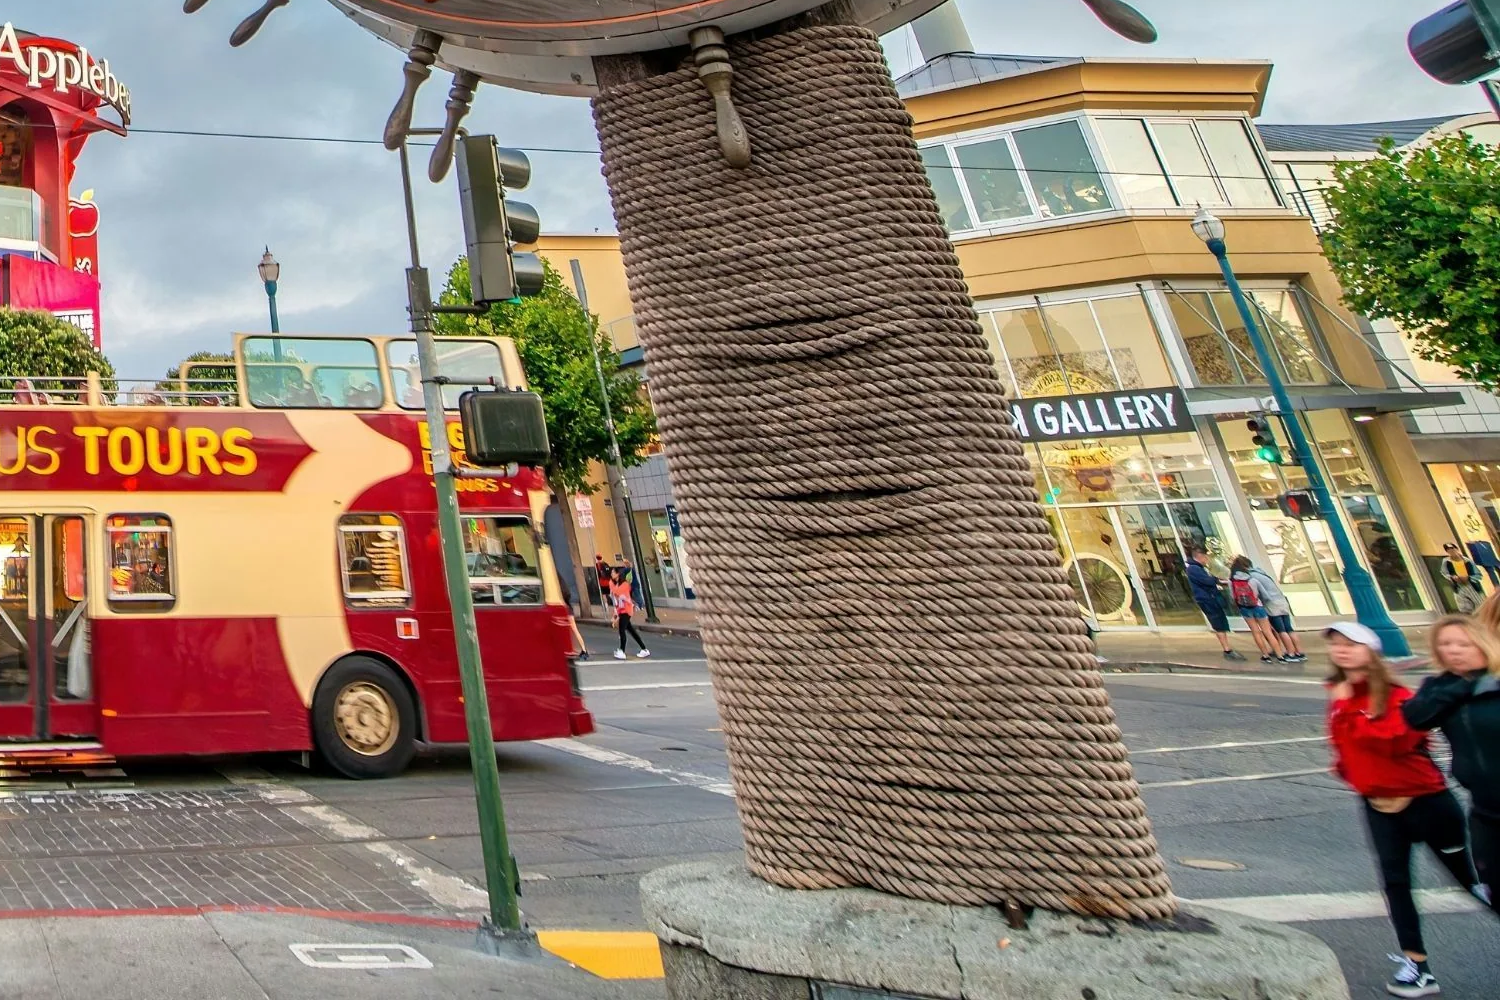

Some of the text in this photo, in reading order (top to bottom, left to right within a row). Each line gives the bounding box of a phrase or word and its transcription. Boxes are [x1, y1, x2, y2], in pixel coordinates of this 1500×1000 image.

[1032, 392, 1178, 436] GALLERY
[72, 426, 258, 476] TOURS
[454, 477, 499, 492] OURS
